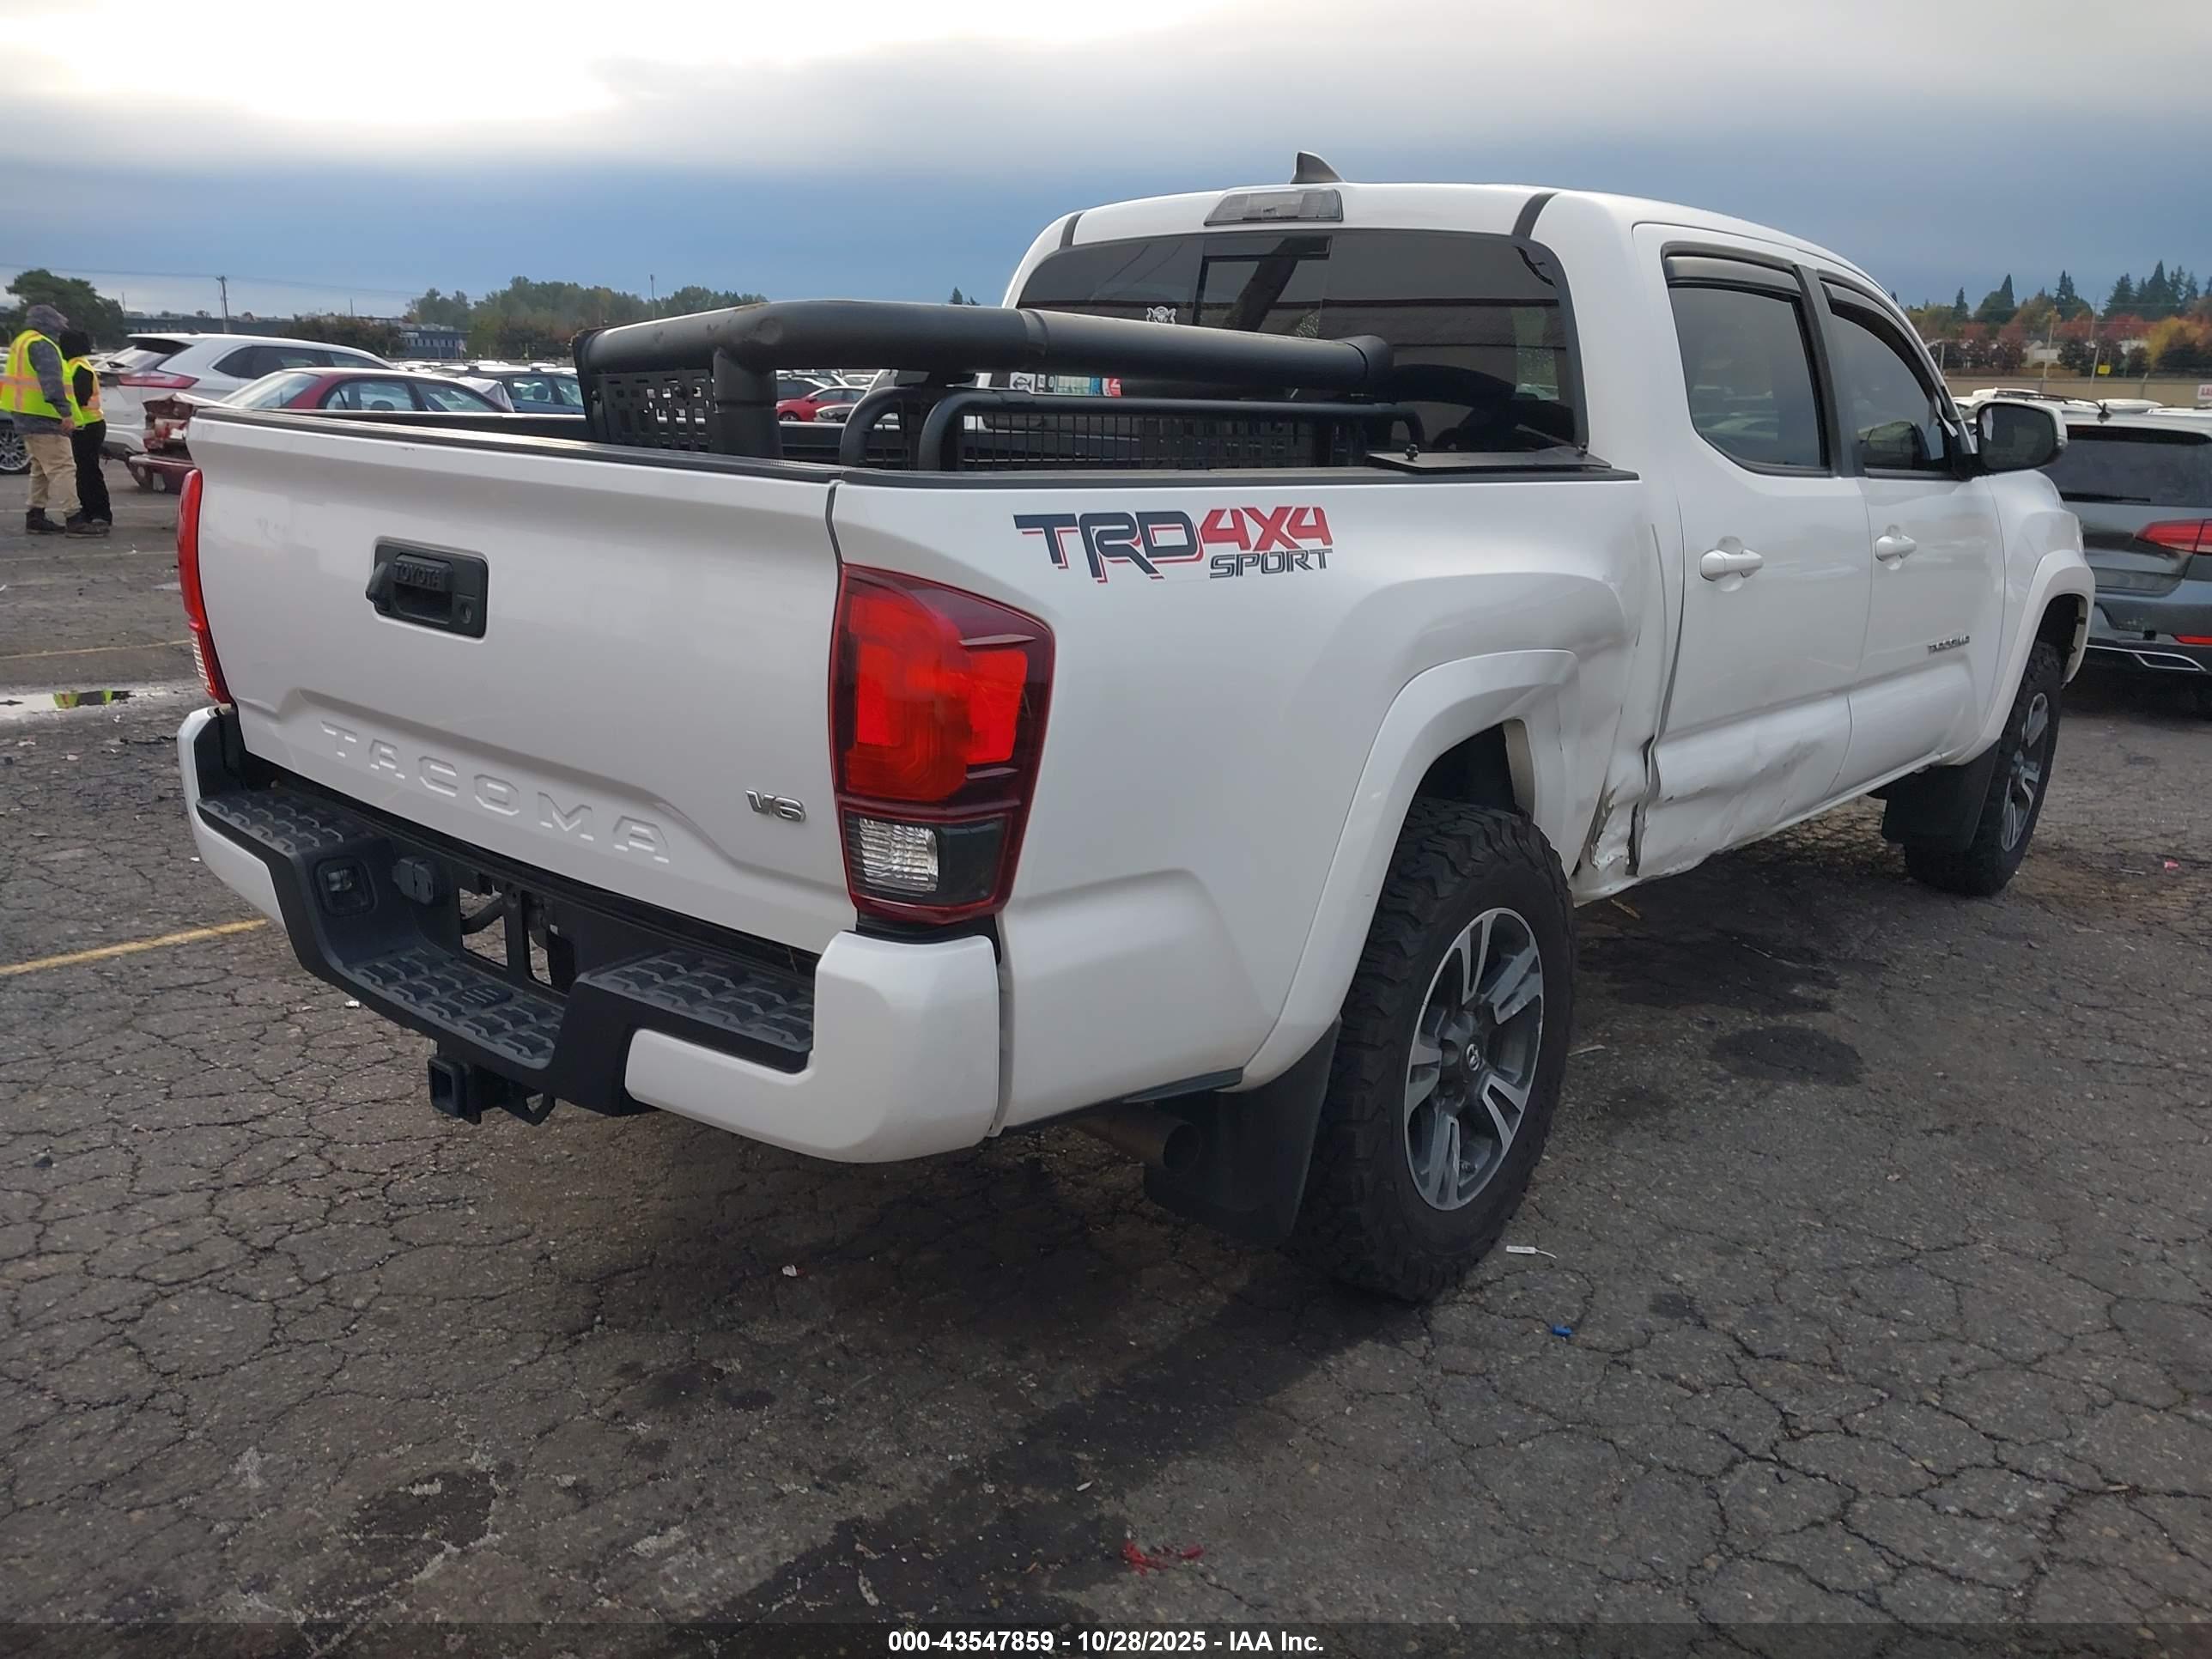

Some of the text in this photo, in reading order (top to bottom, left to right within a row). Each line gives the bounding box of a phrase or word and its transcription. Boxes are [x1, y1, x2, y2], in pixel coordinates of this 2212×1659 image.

[1012, 511, 1204, 584] TRD
[1209, 548, 1334, 579] SPORT
[393, 562, 441, 588] TOYOTA
[320, 720, 670, 865] TACOMA
[744, 788, 807, 823] V6
